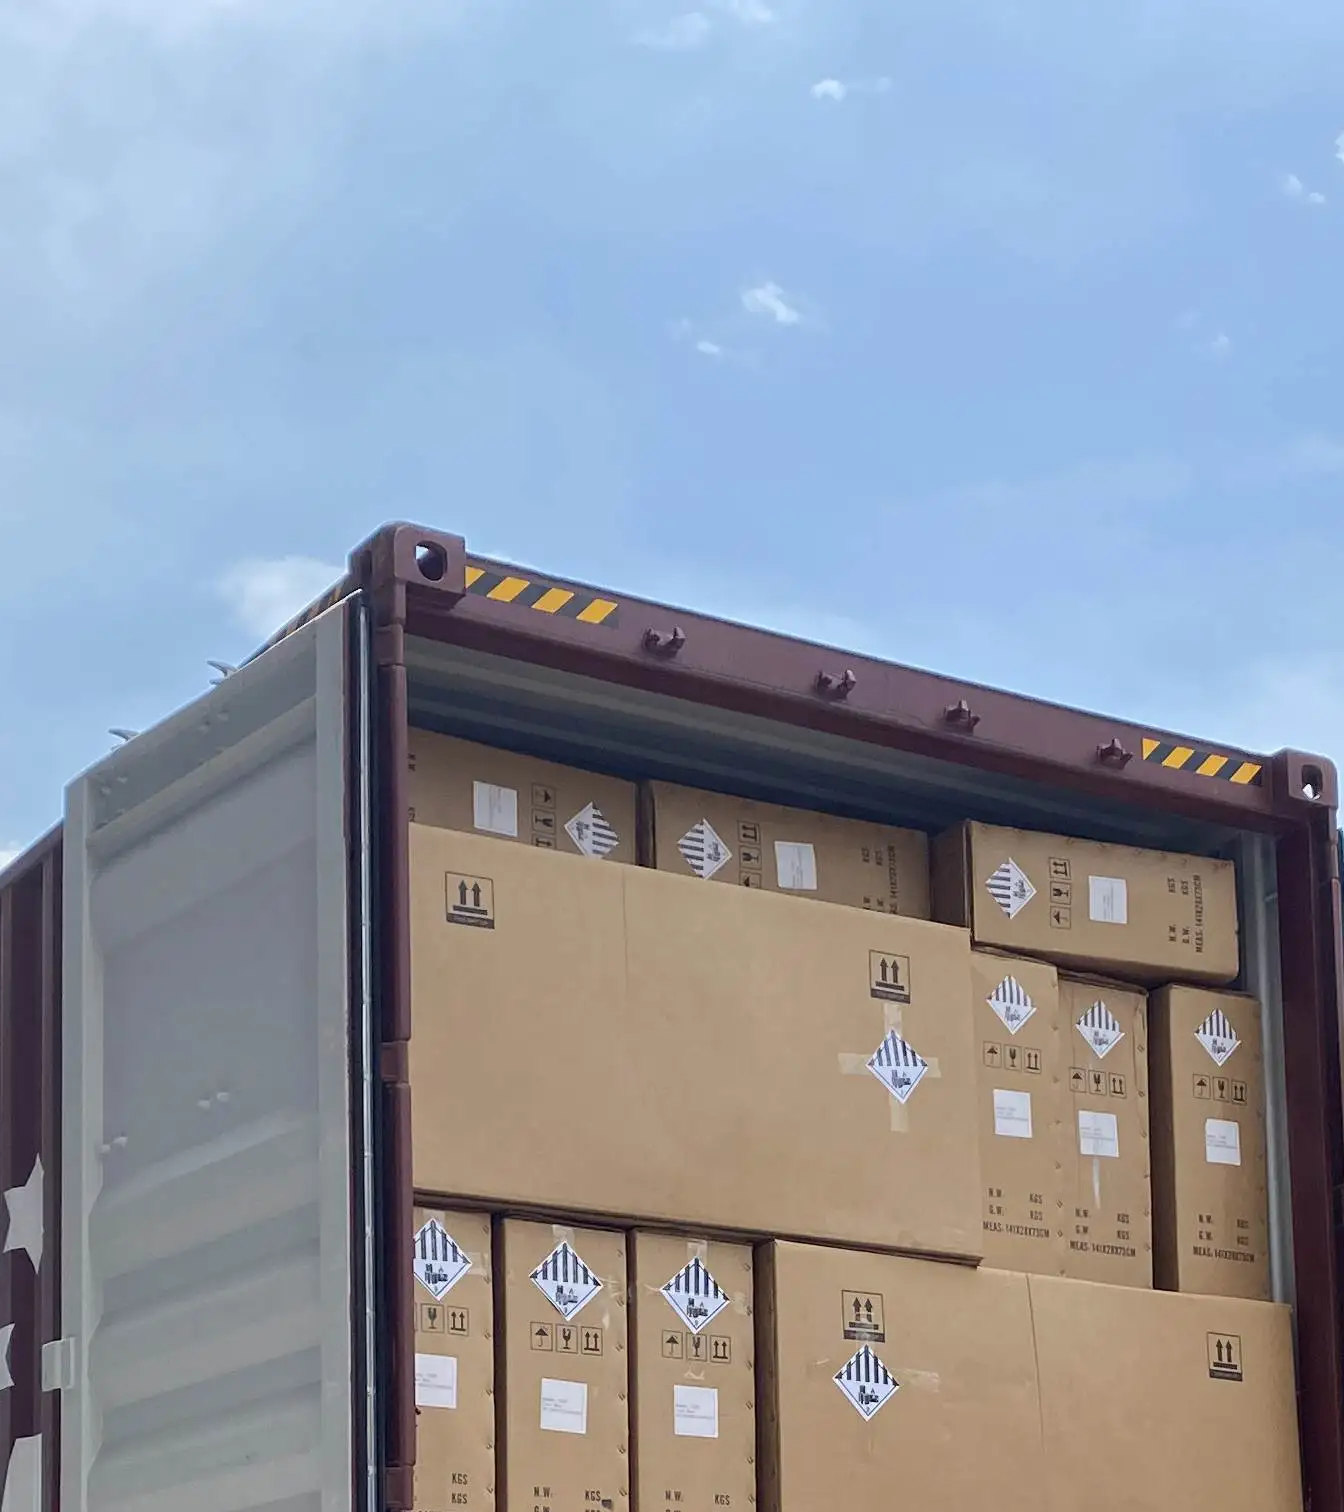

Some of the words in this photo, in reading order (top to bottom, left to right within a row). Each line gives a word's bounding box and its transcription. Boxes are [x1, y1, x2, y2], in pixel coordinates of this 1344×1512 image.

[451, 1472, 468, 1485] KGS
[451, 1493, 468, 1504] KGS
[584, 1490, 601, 1502] KGS
[714, 1494, 731, 1506] KGS
